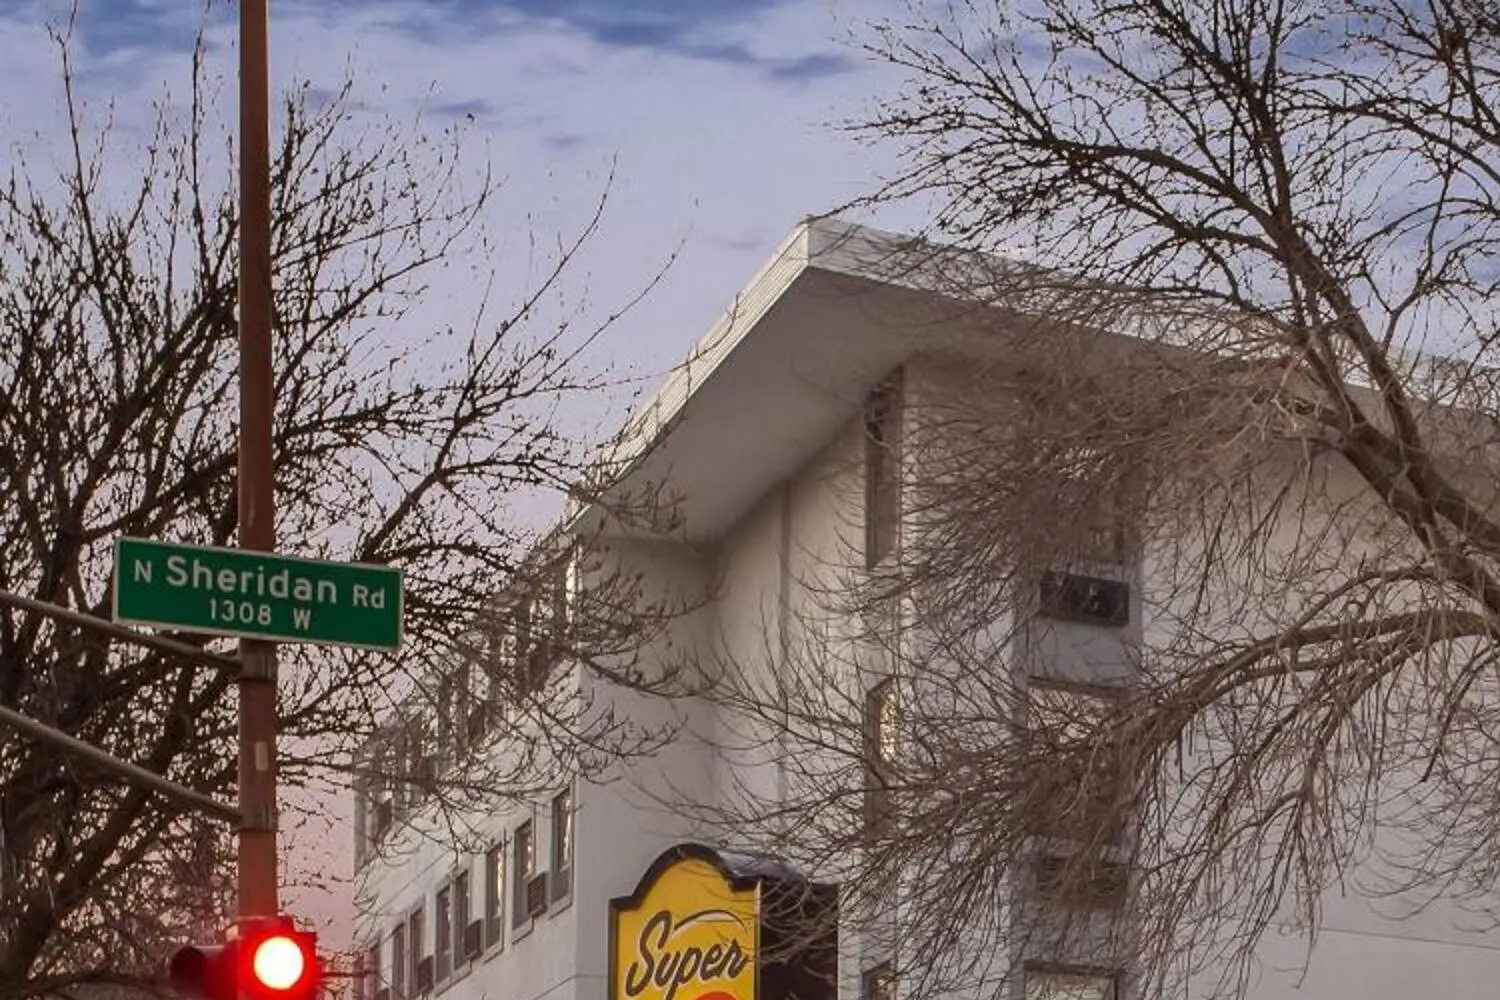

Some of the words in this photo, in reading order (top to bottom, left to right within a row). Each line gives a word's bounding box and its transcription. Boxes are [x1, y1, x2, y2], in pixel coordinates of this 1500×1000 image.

[133, 559, 153, 583] N
[165, 554, 337, 603] Sheridan
[353, 585, 385, 609] Rd
[209, 598, 272, 625] 1308
[293, 607, 312, 630] W
